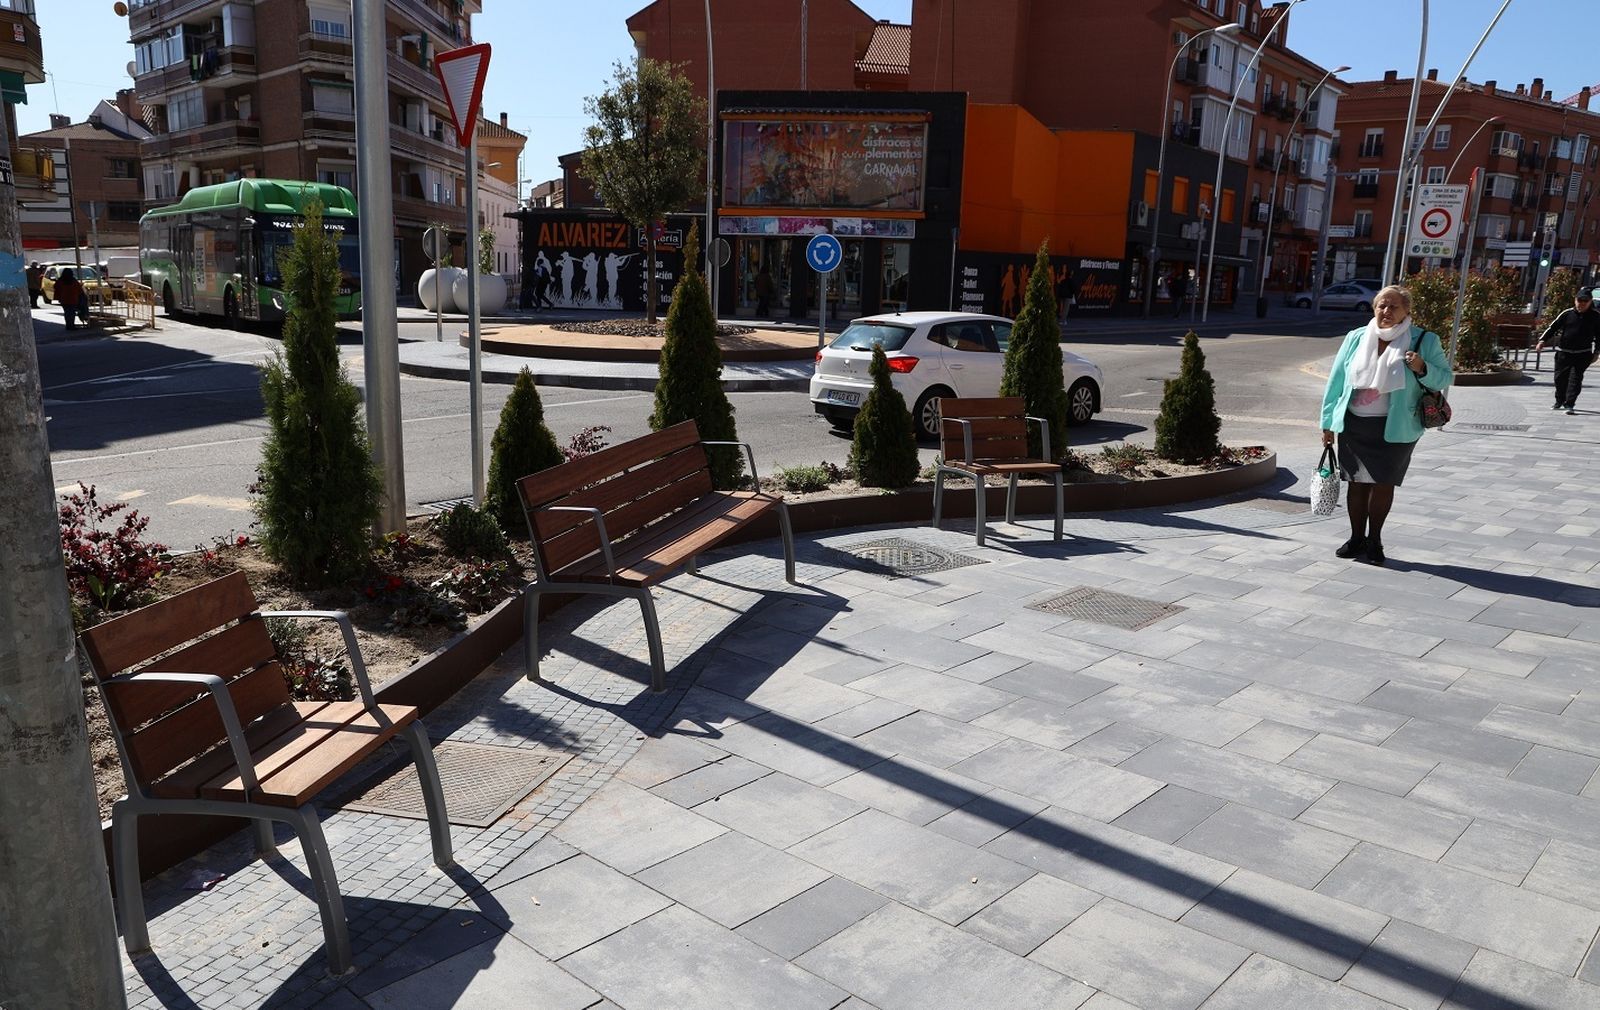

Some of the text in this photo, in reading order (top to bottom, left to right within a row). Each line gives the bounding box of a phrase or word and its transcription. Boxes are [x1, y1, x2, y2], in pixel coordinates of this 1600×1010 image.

[862, 135, 911, 147] disfraces
[864, 162, 917, 177] CARNAVAL
[538, 222, 626, 247] ALVAREZ
